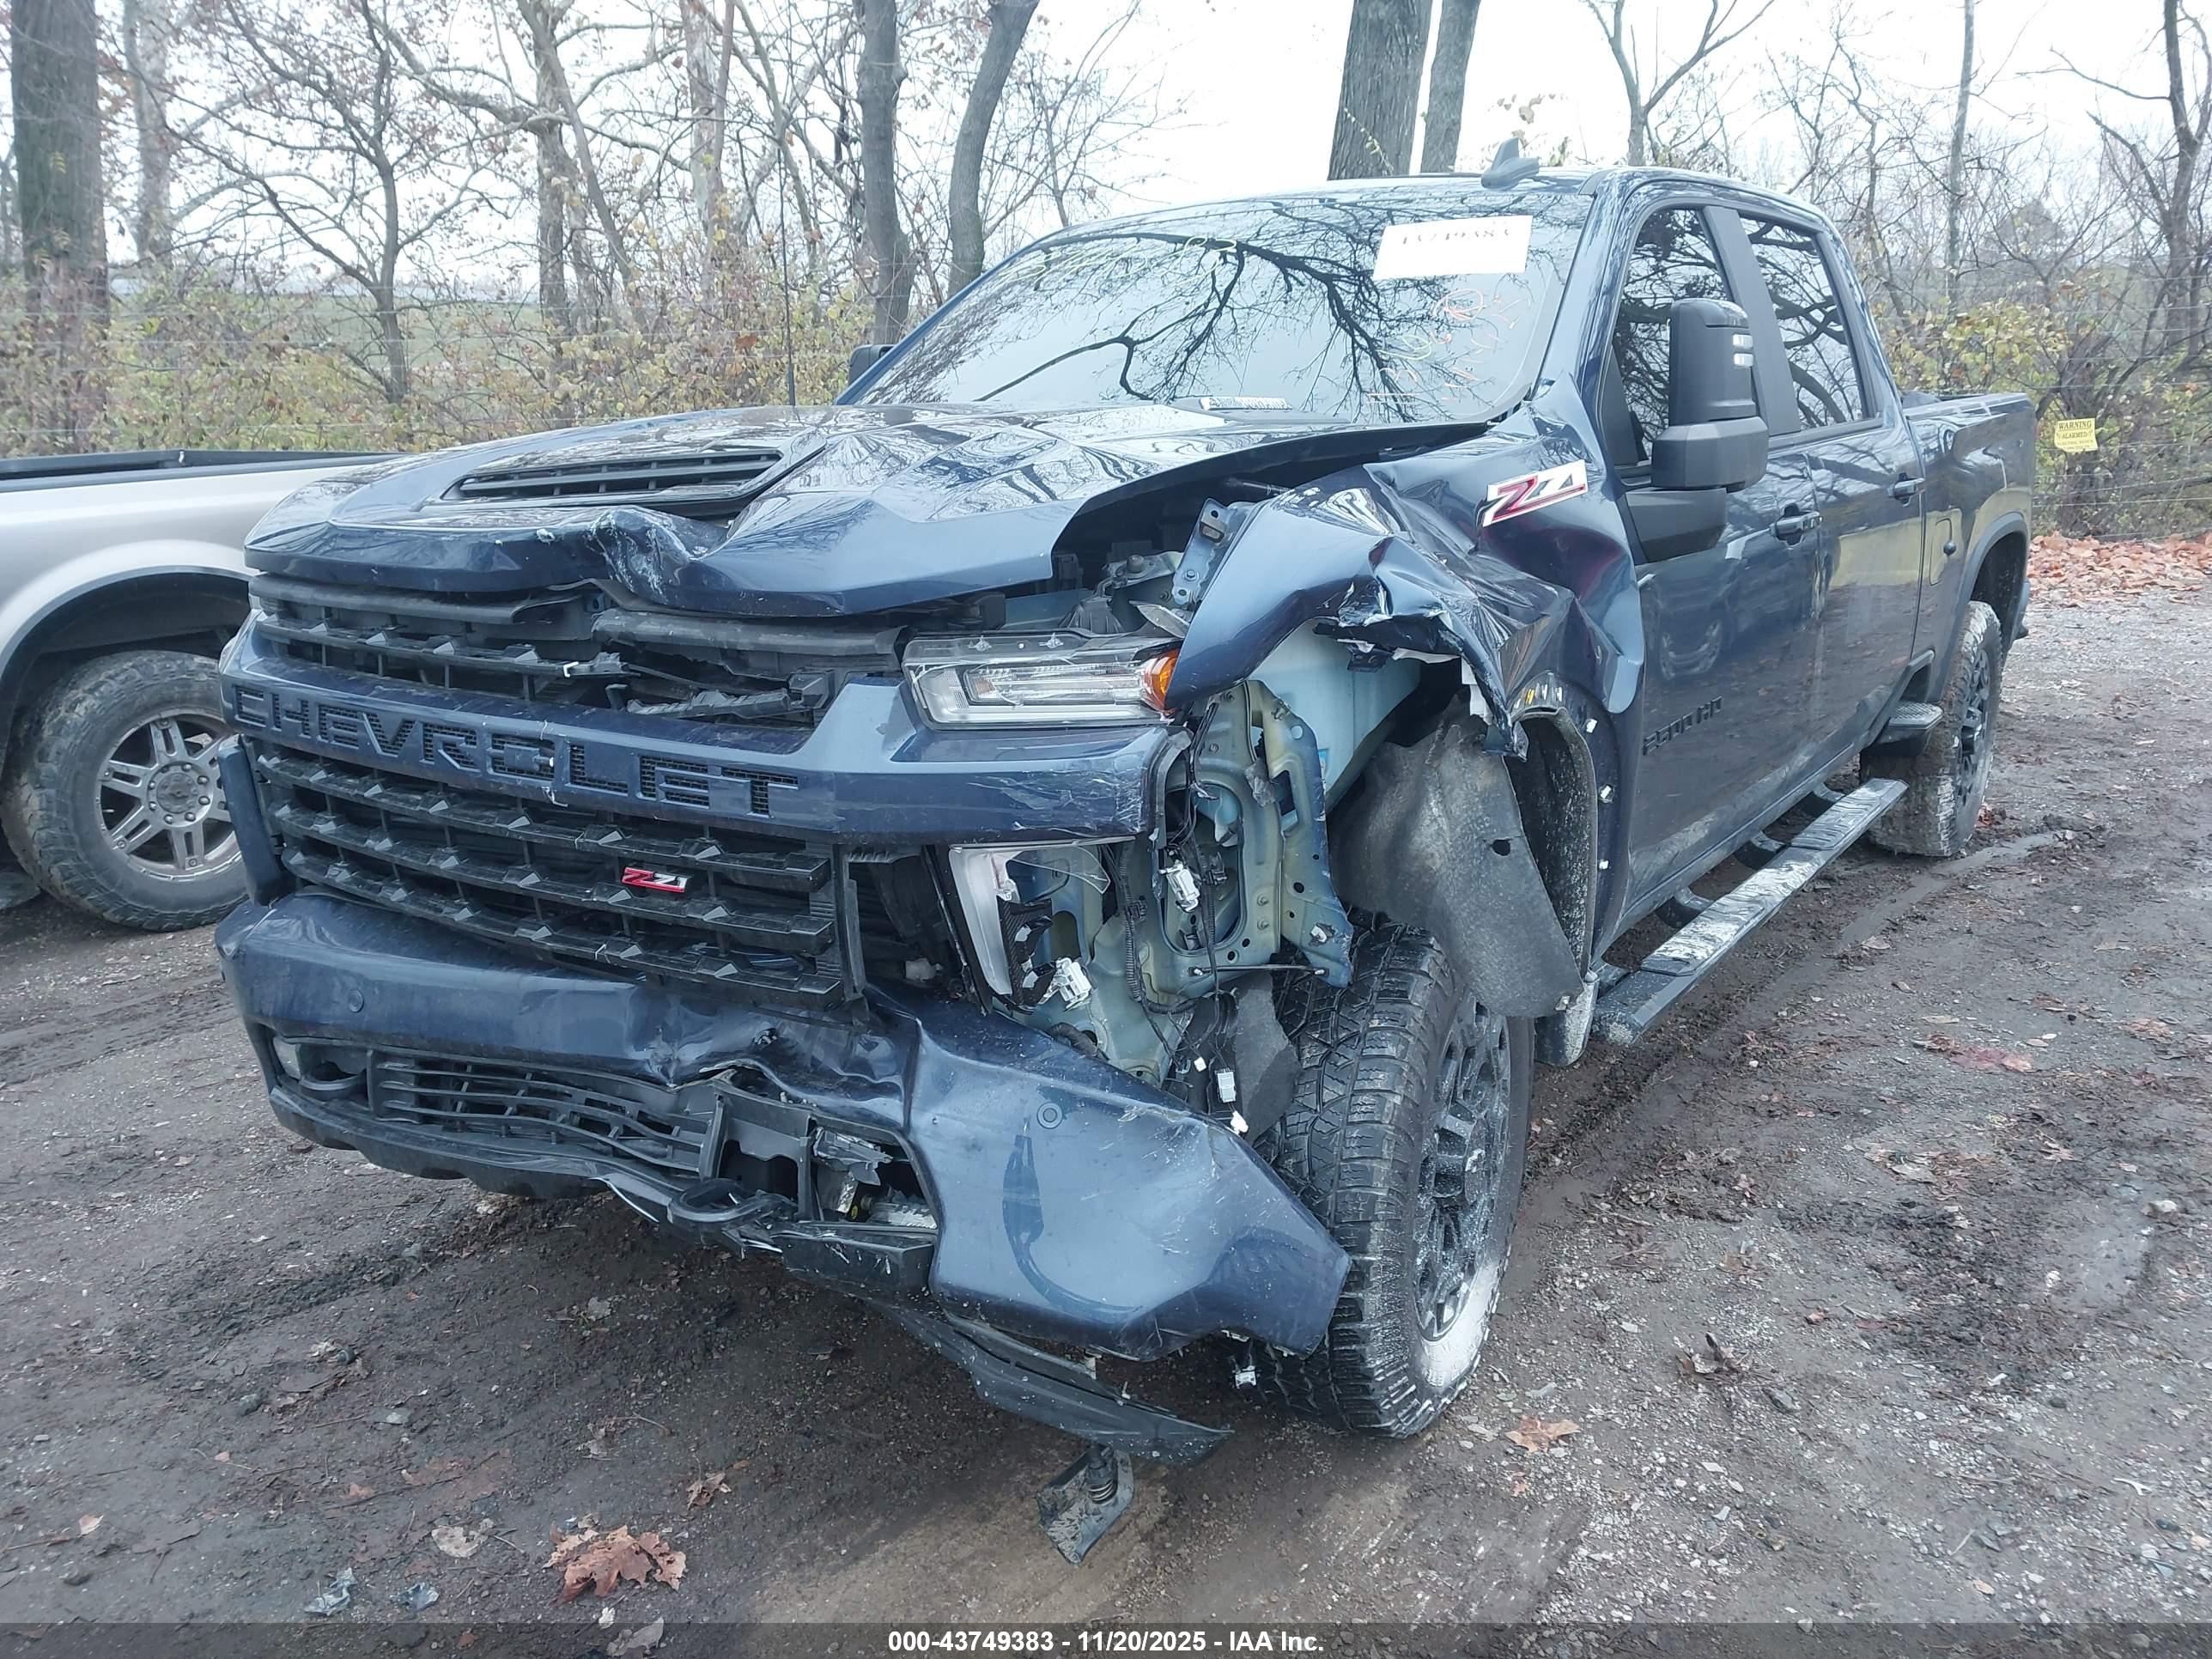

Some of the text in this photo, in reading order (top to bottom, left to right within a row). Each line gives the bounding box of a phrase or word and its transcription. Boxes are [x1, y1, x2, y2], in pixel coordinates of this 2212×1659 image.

[2058, 421, 2092, 429] WARNING
[1486, 460, 1587, 525] Z71
[232, 686, 799, 817] CHEVROLET
[622, 867, 687, 892] Z71
